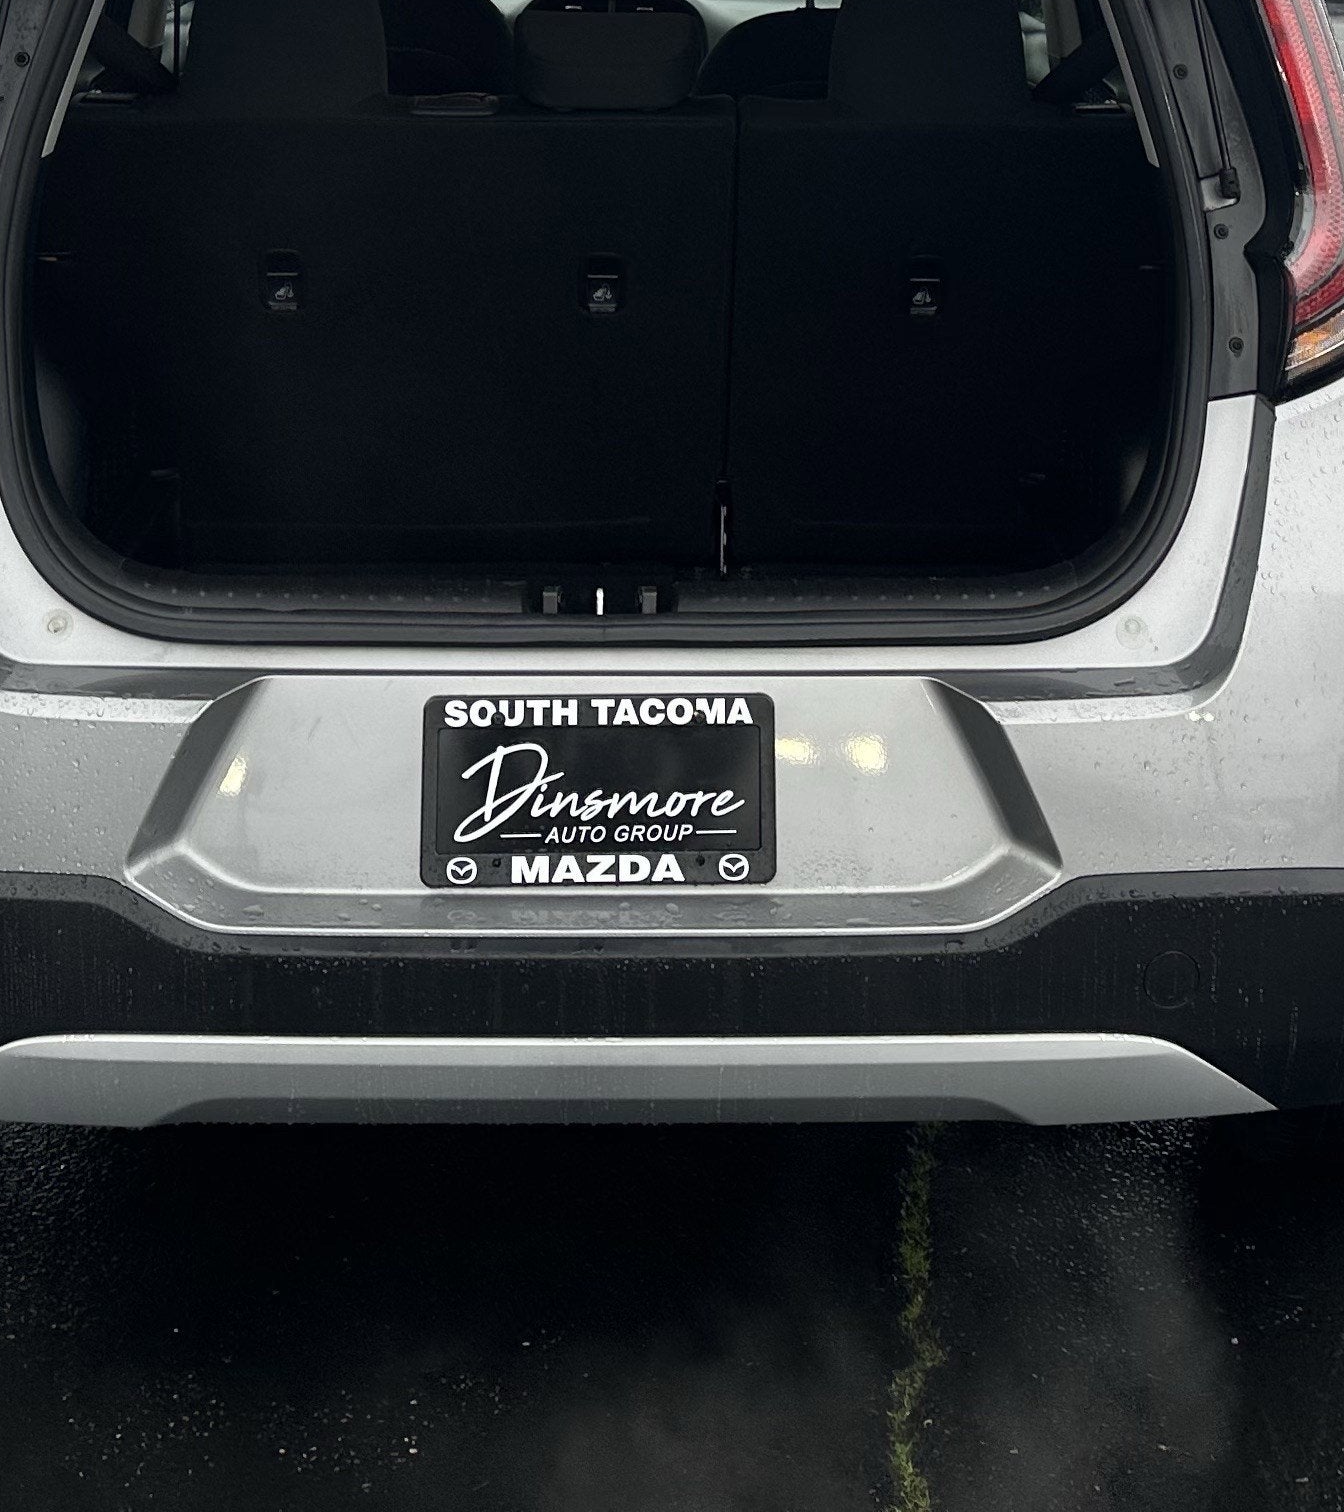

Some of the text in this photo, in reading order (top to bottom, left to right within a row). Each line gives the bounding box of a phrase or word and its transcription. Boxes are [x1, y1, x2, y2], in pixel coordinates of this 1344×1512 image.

[444, 697, 753, 727] SOUTH TACOMA
[453, 743, 745, 843] Dinsmore
[545, 823, 694, 844] AUTO GROUP
[511, 853, 685, 884] MAZDA
